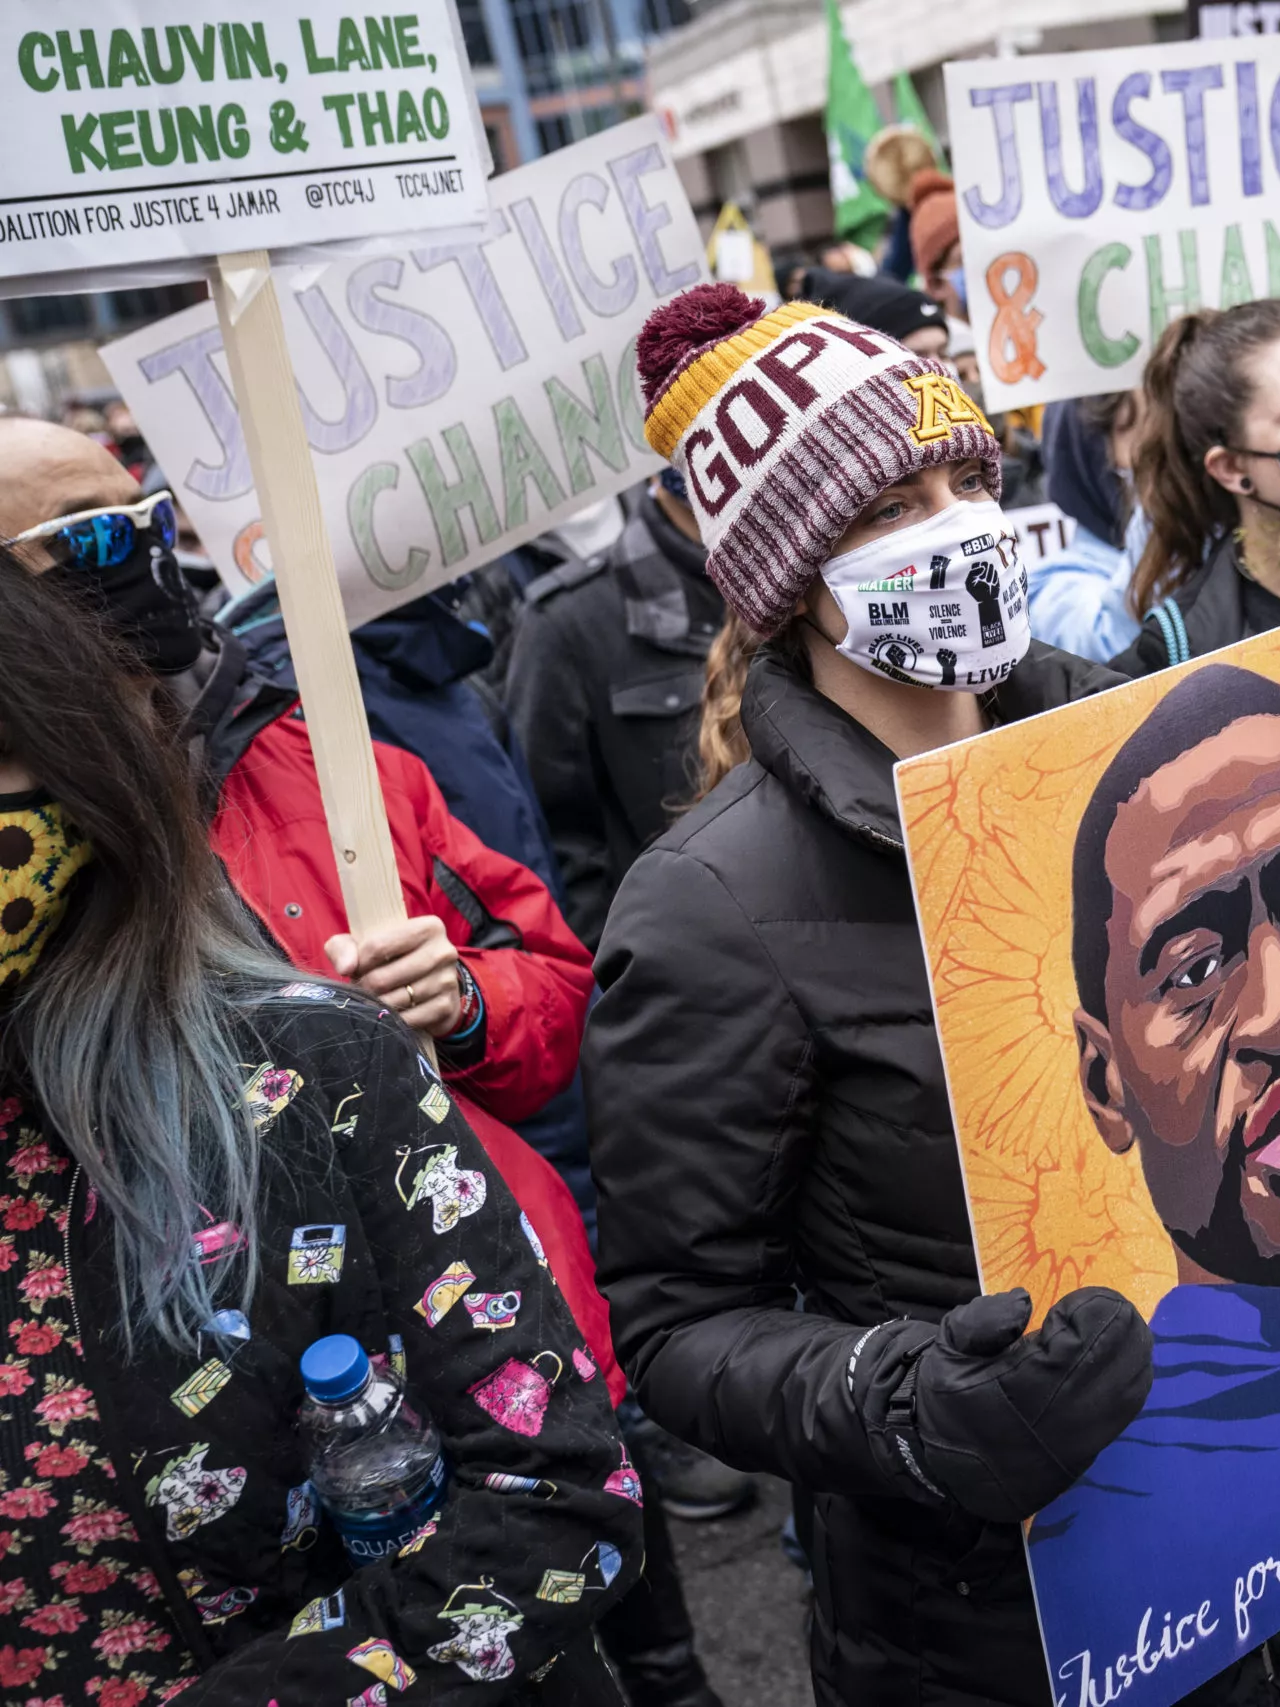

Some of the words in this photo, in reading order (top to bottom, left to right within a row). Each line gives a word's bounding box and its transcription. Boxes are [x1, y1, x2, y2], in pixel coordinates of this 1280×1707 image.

[18, 21, 289, 93] CHAUVIN,
[298, 15, 438, 75] LANE,
[61, 103, 251, 175] KEUNG
[269, 100, 310, 154] &
[322, 87, 450, 149] THAO
[84, 203, 124, 234] FOR
[129, 198, 203, 229] JUSTICE
[207, 195, 219, 220] 4
[226, 189, 281, 220] JAMAR
[305, 180, 375, 209] @TCC4J
[396, 169, 465, 199] TCC4J.NET
[138, 143, 701, 502] JUSTICE
[985, 250, 1048, 385] &
[963, 533, 995, 556] #BLM
[868, 602, 909, 619] BLM
[929, 603, 961, 618] SILENCE
[868, 633, 894, 654] BLACK
[896, 633, 925, 654] LIVES
[929, 624, 967, 640] VIOLENCE
[966, 658, 1018, 685] LIVES
[345, 1529, 417, 1557] QUAF
[1057, 1599, 1220, 1707] Justice
